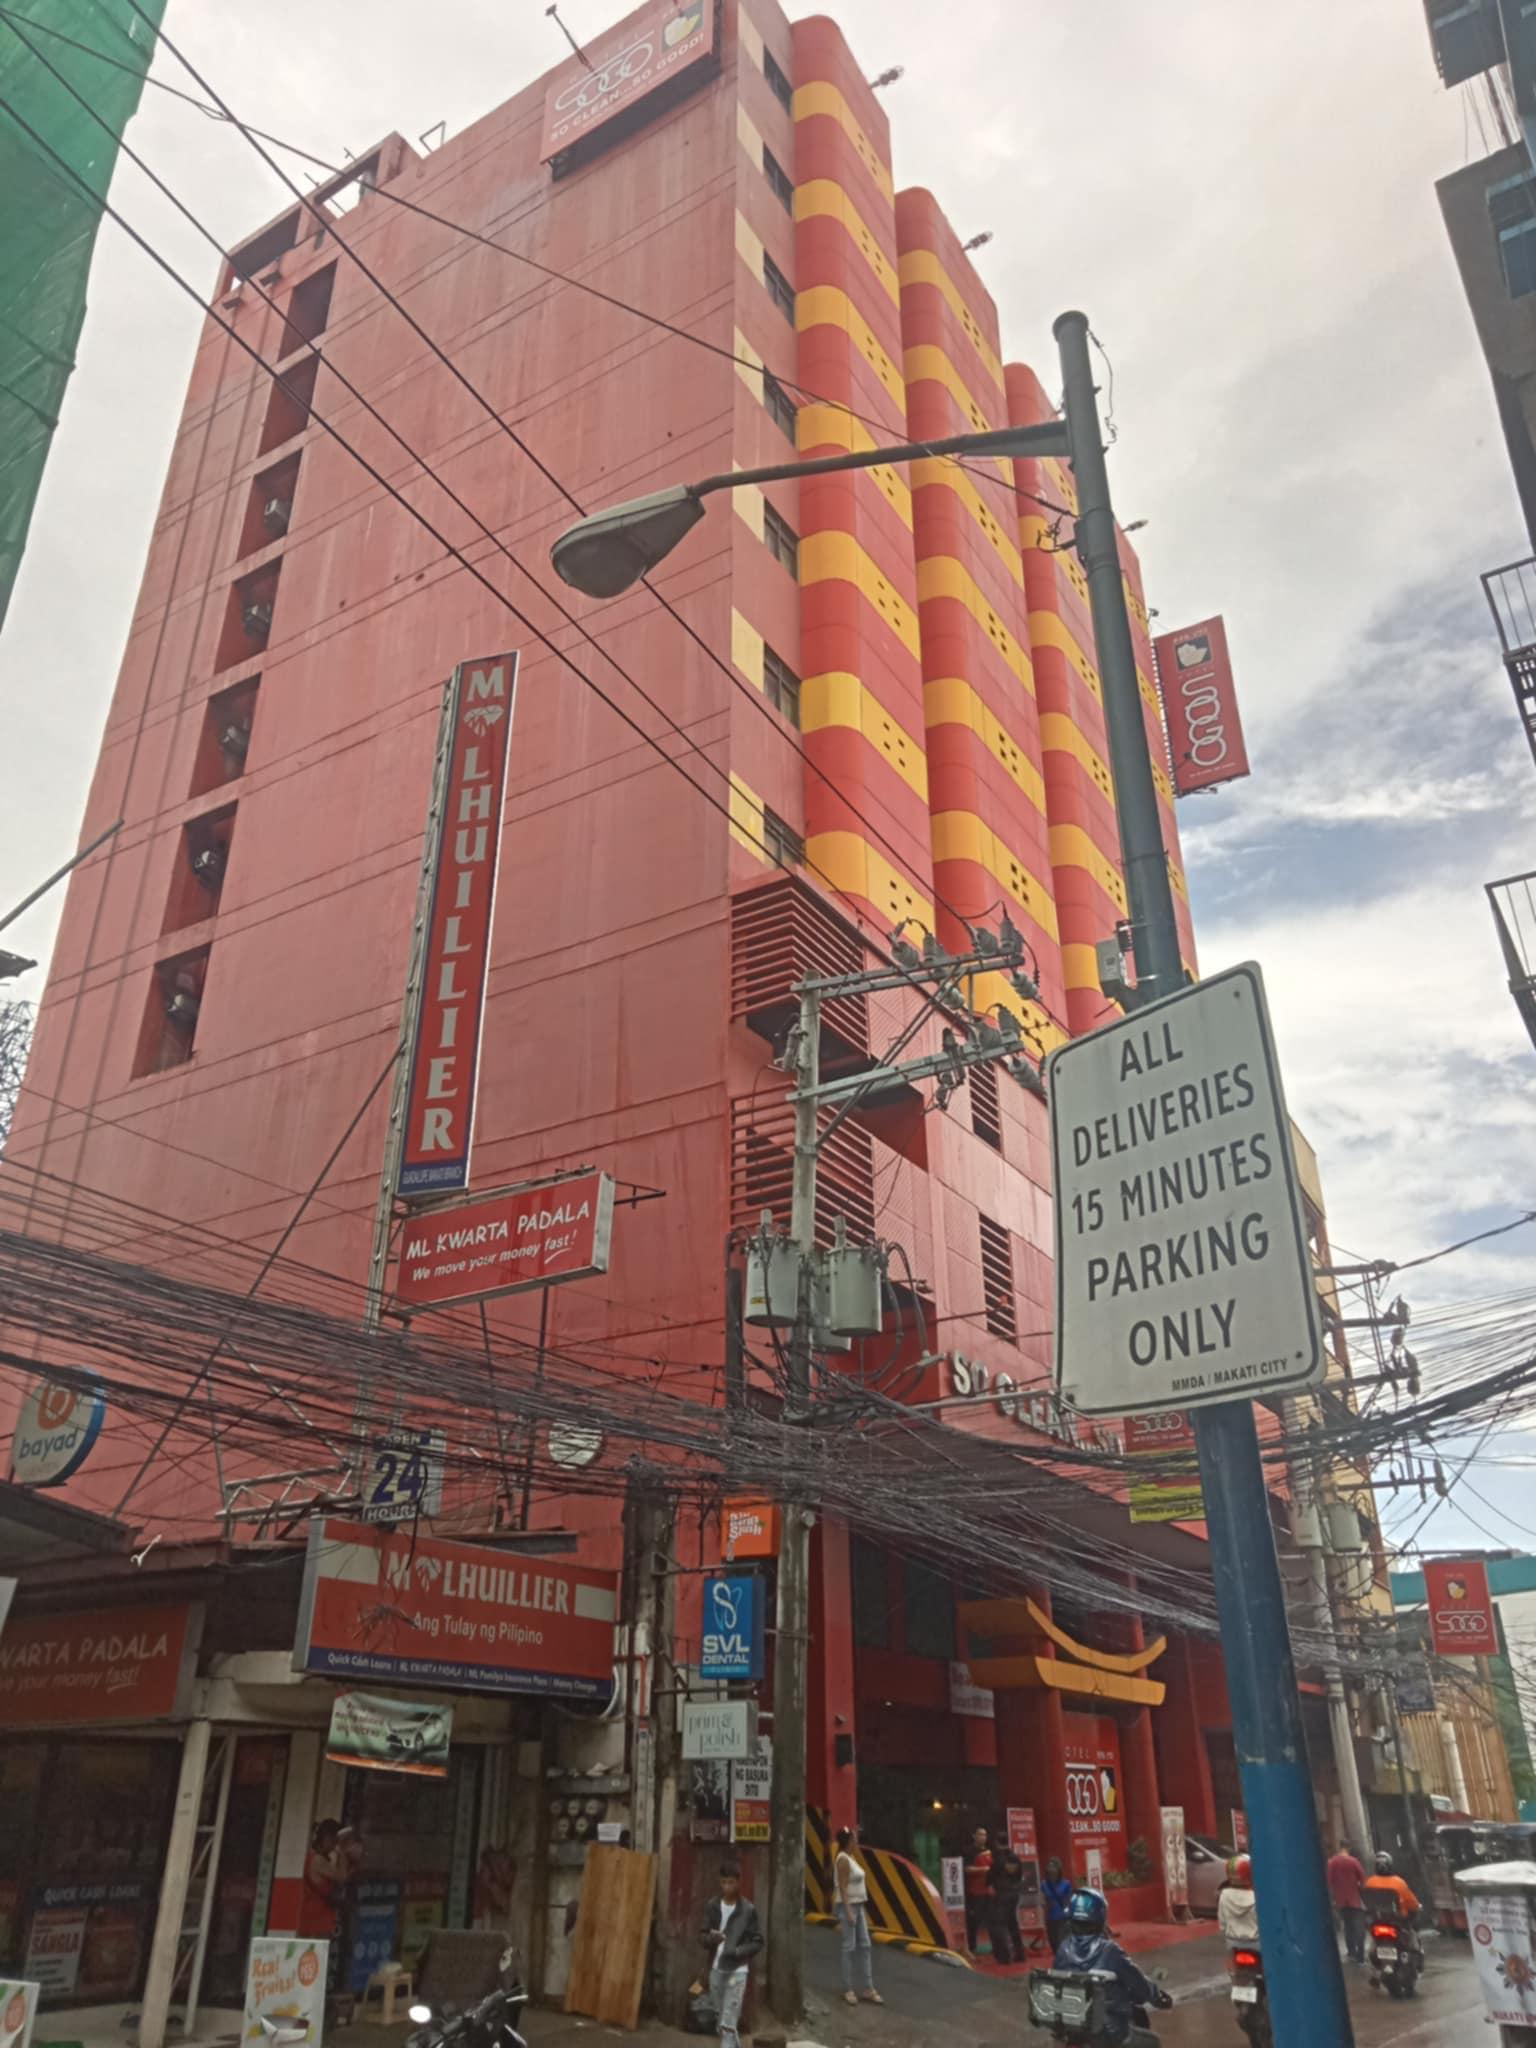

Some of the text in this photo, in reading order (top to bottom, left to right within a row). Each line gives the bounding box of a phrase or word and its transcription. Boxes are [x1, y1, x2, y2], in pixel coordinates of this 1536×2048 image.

[1182, 672, 1228, 767] SOGO
[1119, 1021, 1185, 1082] ALL
[1073, 1062, 1255, 1168] DELIVERIES
[1072, 1132, 1272, 1234] 15 MINUTES
[406, 1199, 591, 1261] ML KWARTA PADALA
[413, 1229, 578, 1281] We move your money fast!
[1087, 1212, 1270, 1302] PARKING
[1128, 1298, 1237, 1367] ONLY
[1172, 1376, 1206, 1393] MMDA
[1213, 1365, 1257, 1386] MAKATI
[1260, 1357, 1289, 1377] CITY
[18, 1428, 78, 1461] bayad
[371, 1453, 423, 1504] 24
[442, 1559, 570, 1615] LHUILLIER
[412, 1612, 543, 1645] Ang Tulay ng Pilipino
[703, 1634, 750, 1654] SVL
[1436, 1610, 1488, 1634] SOGO
[78, 1633, 168, 1664] PADALA
[703, 1654, 749, 1665] DENTAL
[54, 1671, 103, 1689] money
